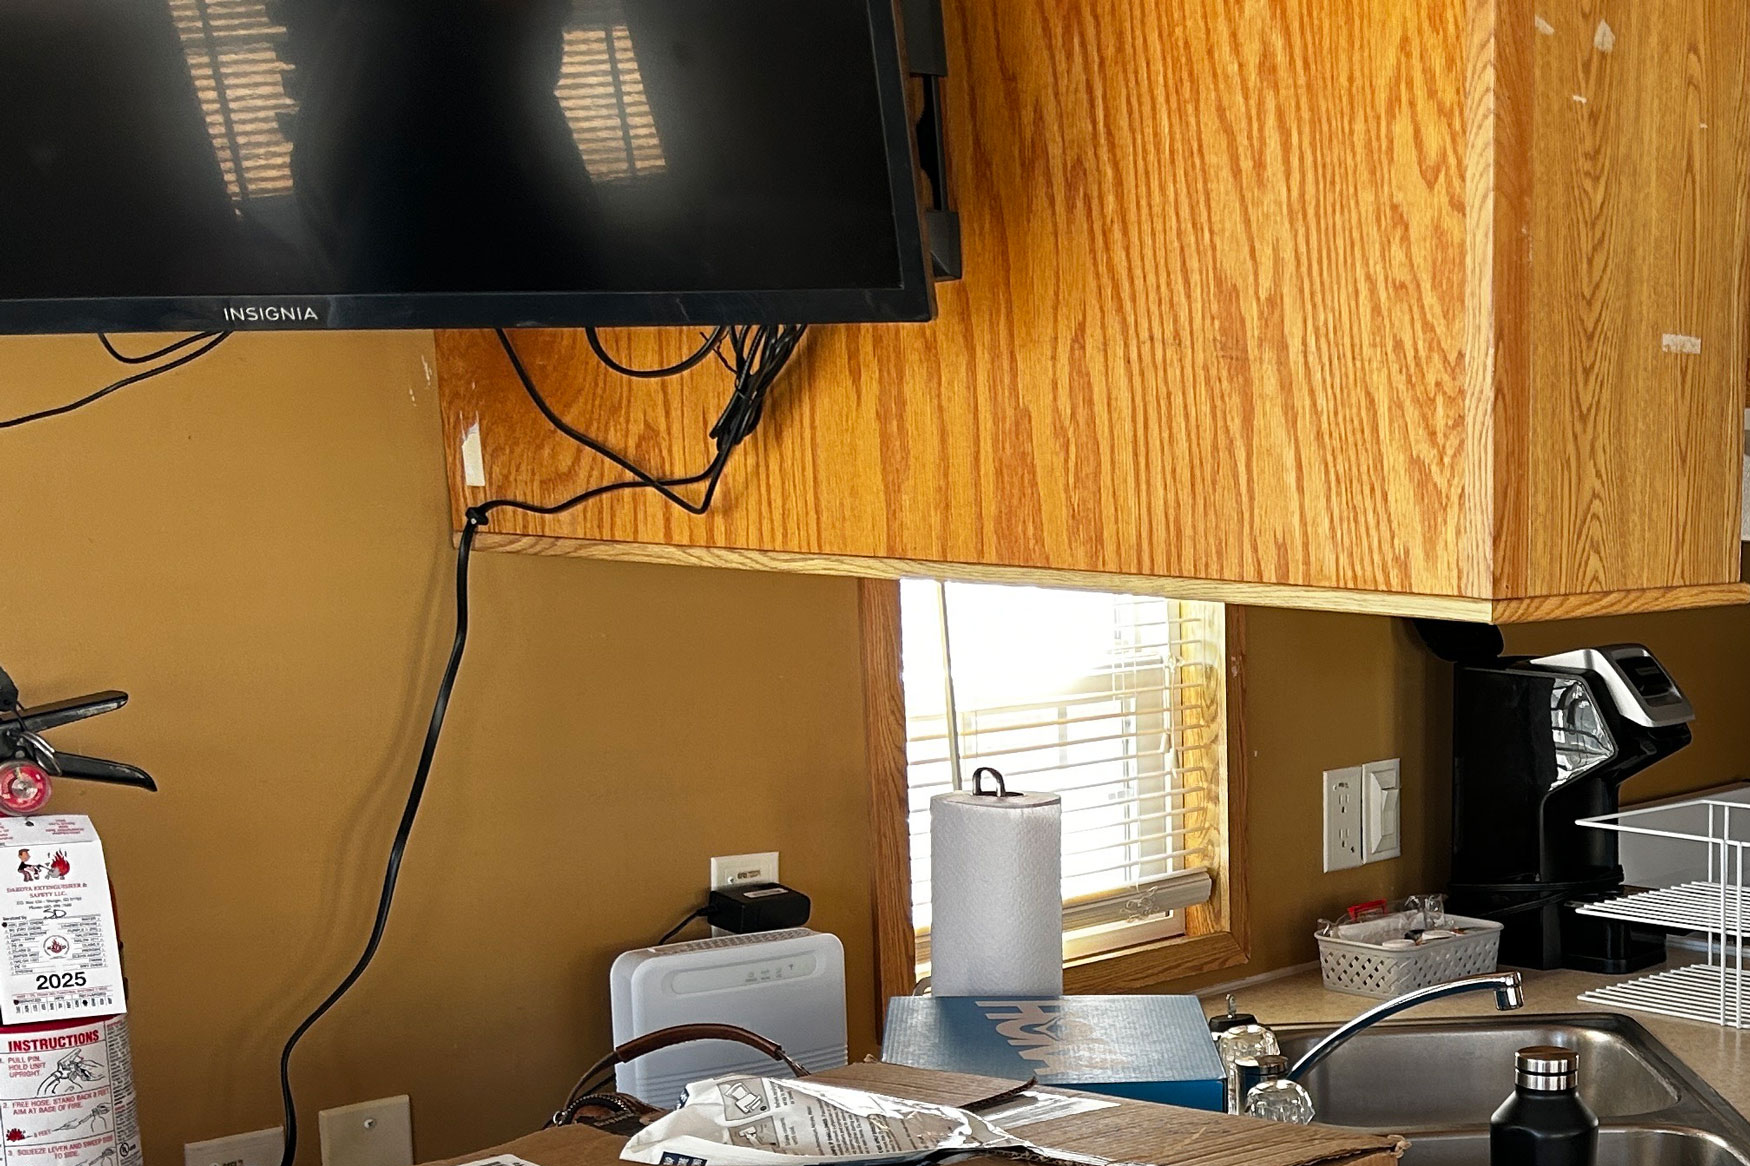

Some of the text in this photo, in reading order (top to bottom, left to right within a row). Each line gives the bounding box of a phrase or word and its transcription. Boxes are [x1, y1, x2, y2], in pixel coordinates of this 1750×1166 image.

[223, 306, 319, 321] INSIGNIA
[36, 971, 87, 990] 2025
[8, 1029, 99, 1052] INSTRUCTIONS
[7, 1056, 27, 1064] PULL
[8, 1063, 28, 1071] HOLD
[53, 1096, 75, 1104] STAND
[76, 1093, 92, 1101] BACK
[39, 1105, 57, 1113] BASE
[17, 1147, 47, 1156] SQUEEZE
[48, 1145, 68, 1154] LEVER
[69, 1143, 82, 1151] AND
